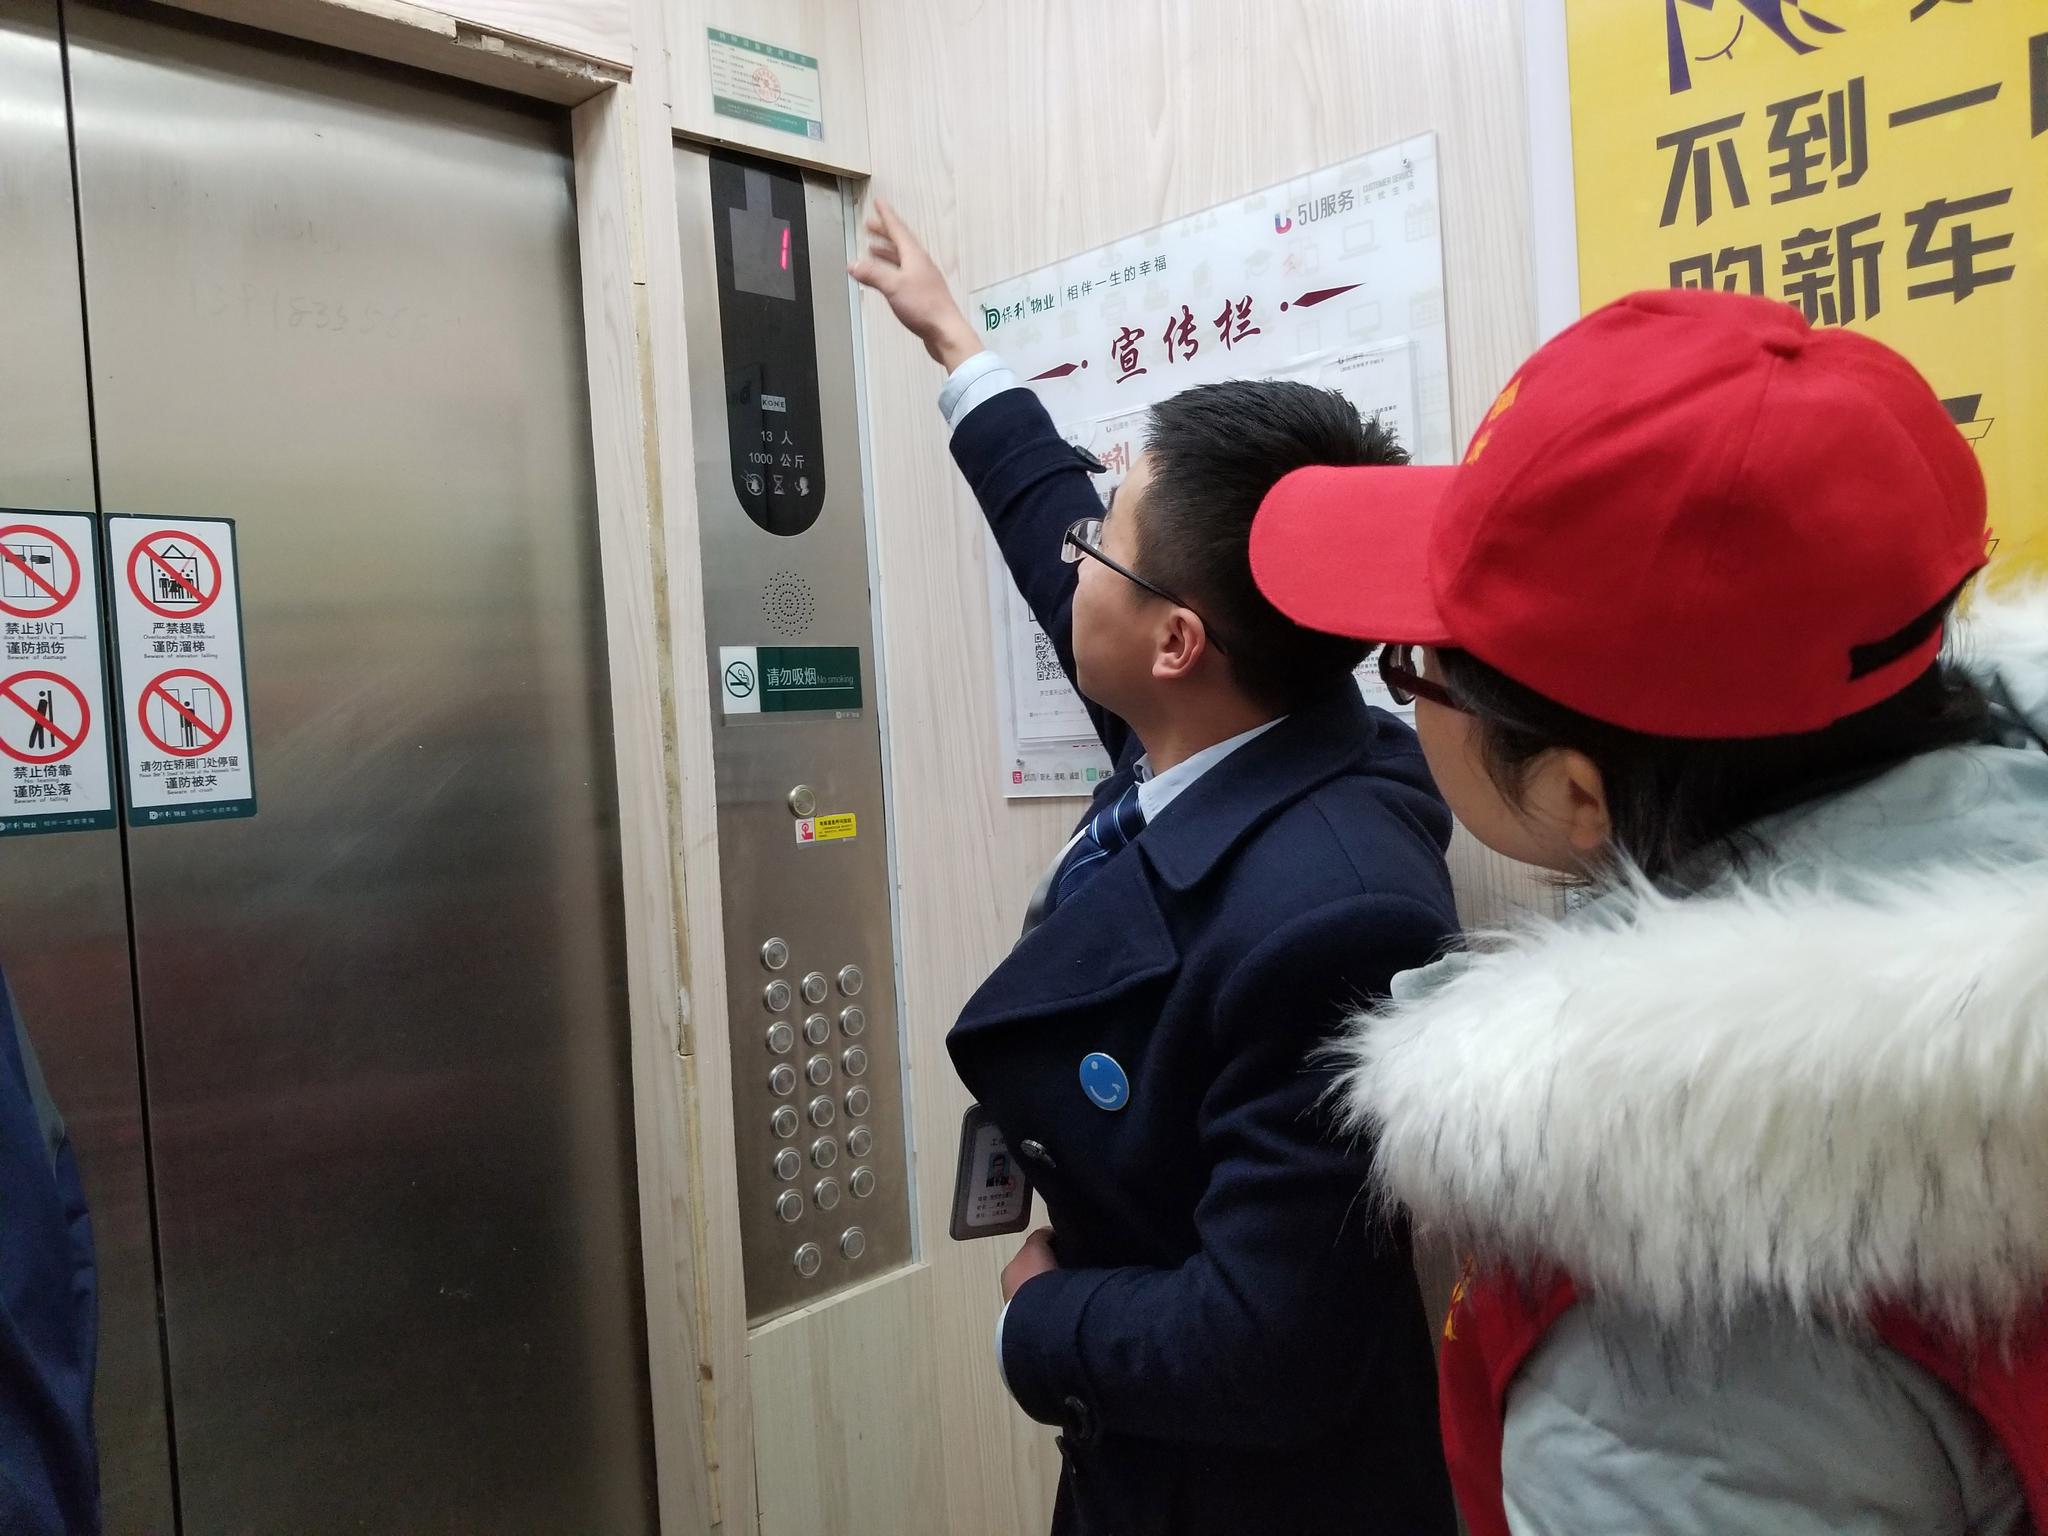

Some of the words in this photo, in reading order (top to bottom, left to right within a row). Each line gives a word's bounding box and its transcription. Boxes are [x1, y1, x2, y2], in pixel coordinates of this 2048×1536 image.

[1655, 32, 2048, 229] 不到一
[1297, 189, 1355, 227] 5U服务
[779, 227, 791, 271] 1
[1066, 254, 1168, 302] 相伴一生的幸福
[1111, 295, 1261, 384] 宣传栏
[762, 399, 785, 409] KONE
[760, 430, 774, 442] 13
[781, 430, 793, 446] 人
[748, 452, 774, 465] 1000
[780, 453, 805, 470] 公斤
[5, 622, 64, 635] 禁止扒门
[152, 622, 206, 635] 严禁超载
[6, 641, 65, 655] 谨防损伤
[152, 640, 206, 653] 谨防溜梯
[766, 667, 817, 687] 请勿吸烟
[13, 764, 72, 779] 禁止倚靠
[139, 755, 239, 773] 请勿在轿厢门处停留
[13, 782, 72, 799] 谨防坠落
[165, 775, 218, 790] 谨防被夹
